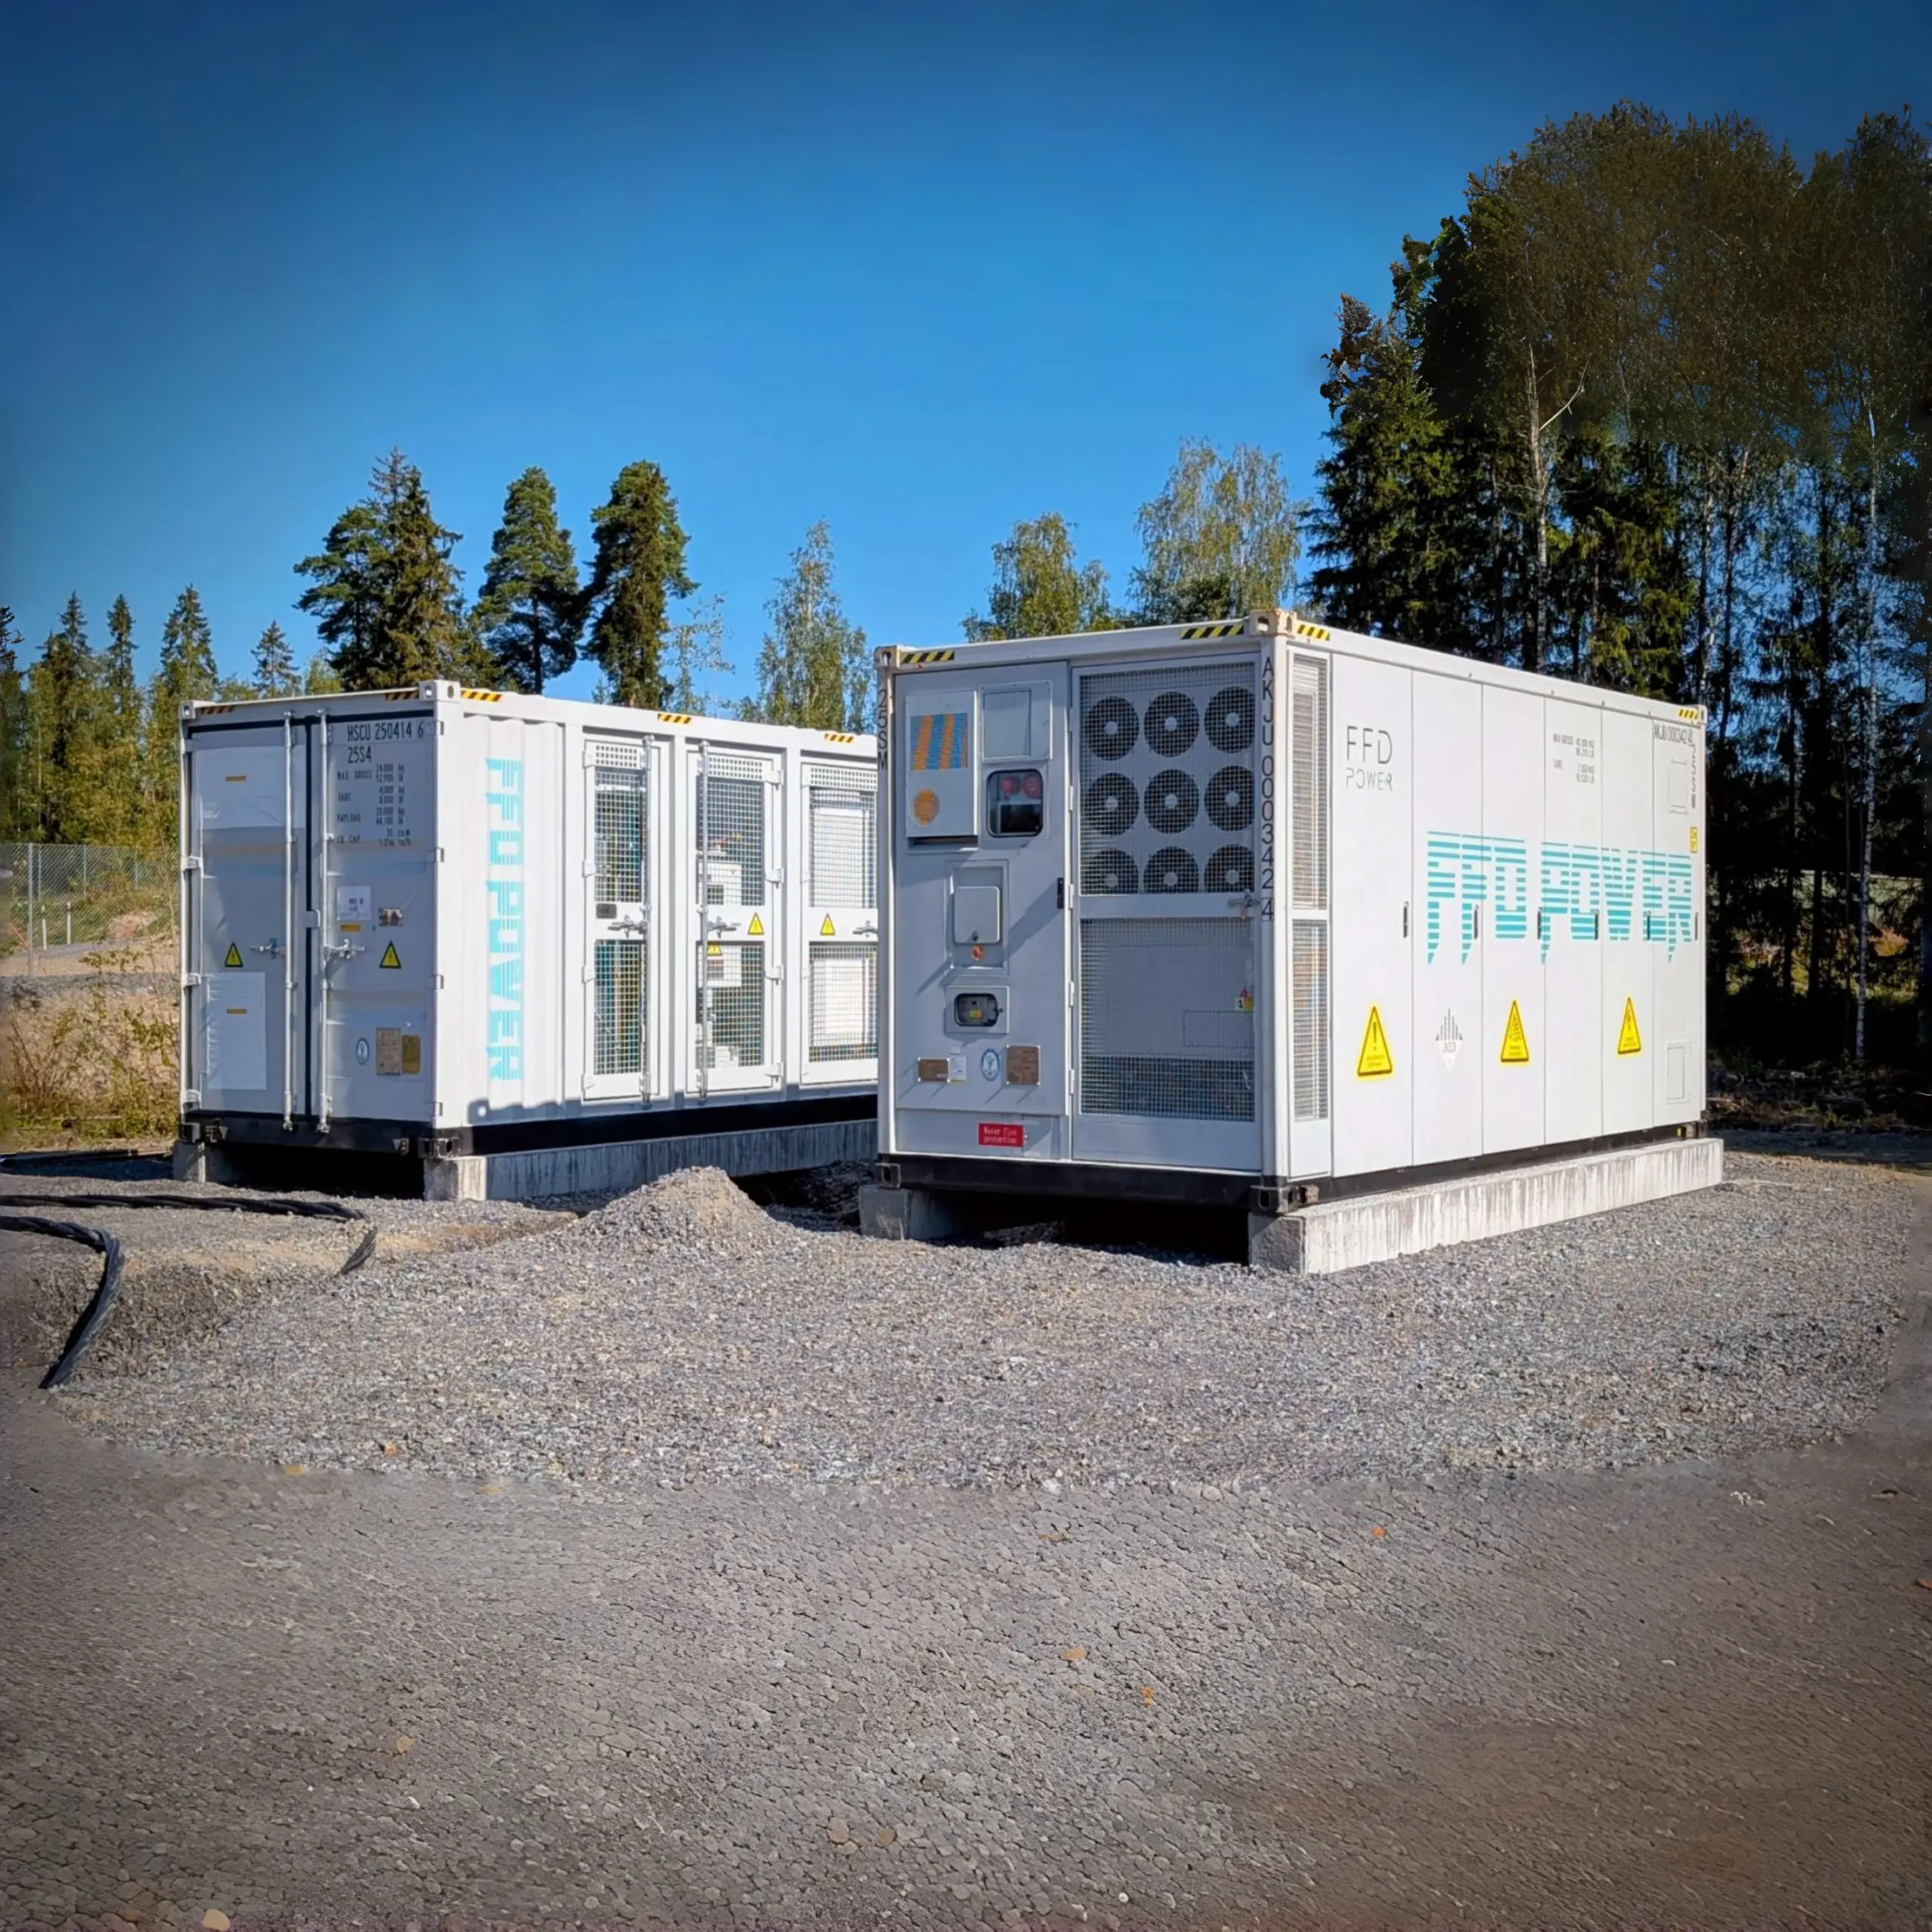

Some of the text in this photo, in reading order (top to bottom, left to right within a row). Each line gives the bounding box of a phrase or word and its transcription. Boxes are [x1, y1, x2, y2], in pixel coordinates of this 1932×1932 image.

[1261, 656, 1275, 746] AKJU
[347, 721, 424, 742] HSCU 250414 6
[1346, 725, 1393, 764] FFD
[347, 745, 372, 764] 25S4
[1346, 767, 1393, 792] POWER
[1261, 755, 1275, 890] 000342
[1427, 831, 1692, 965] FFD POWER
